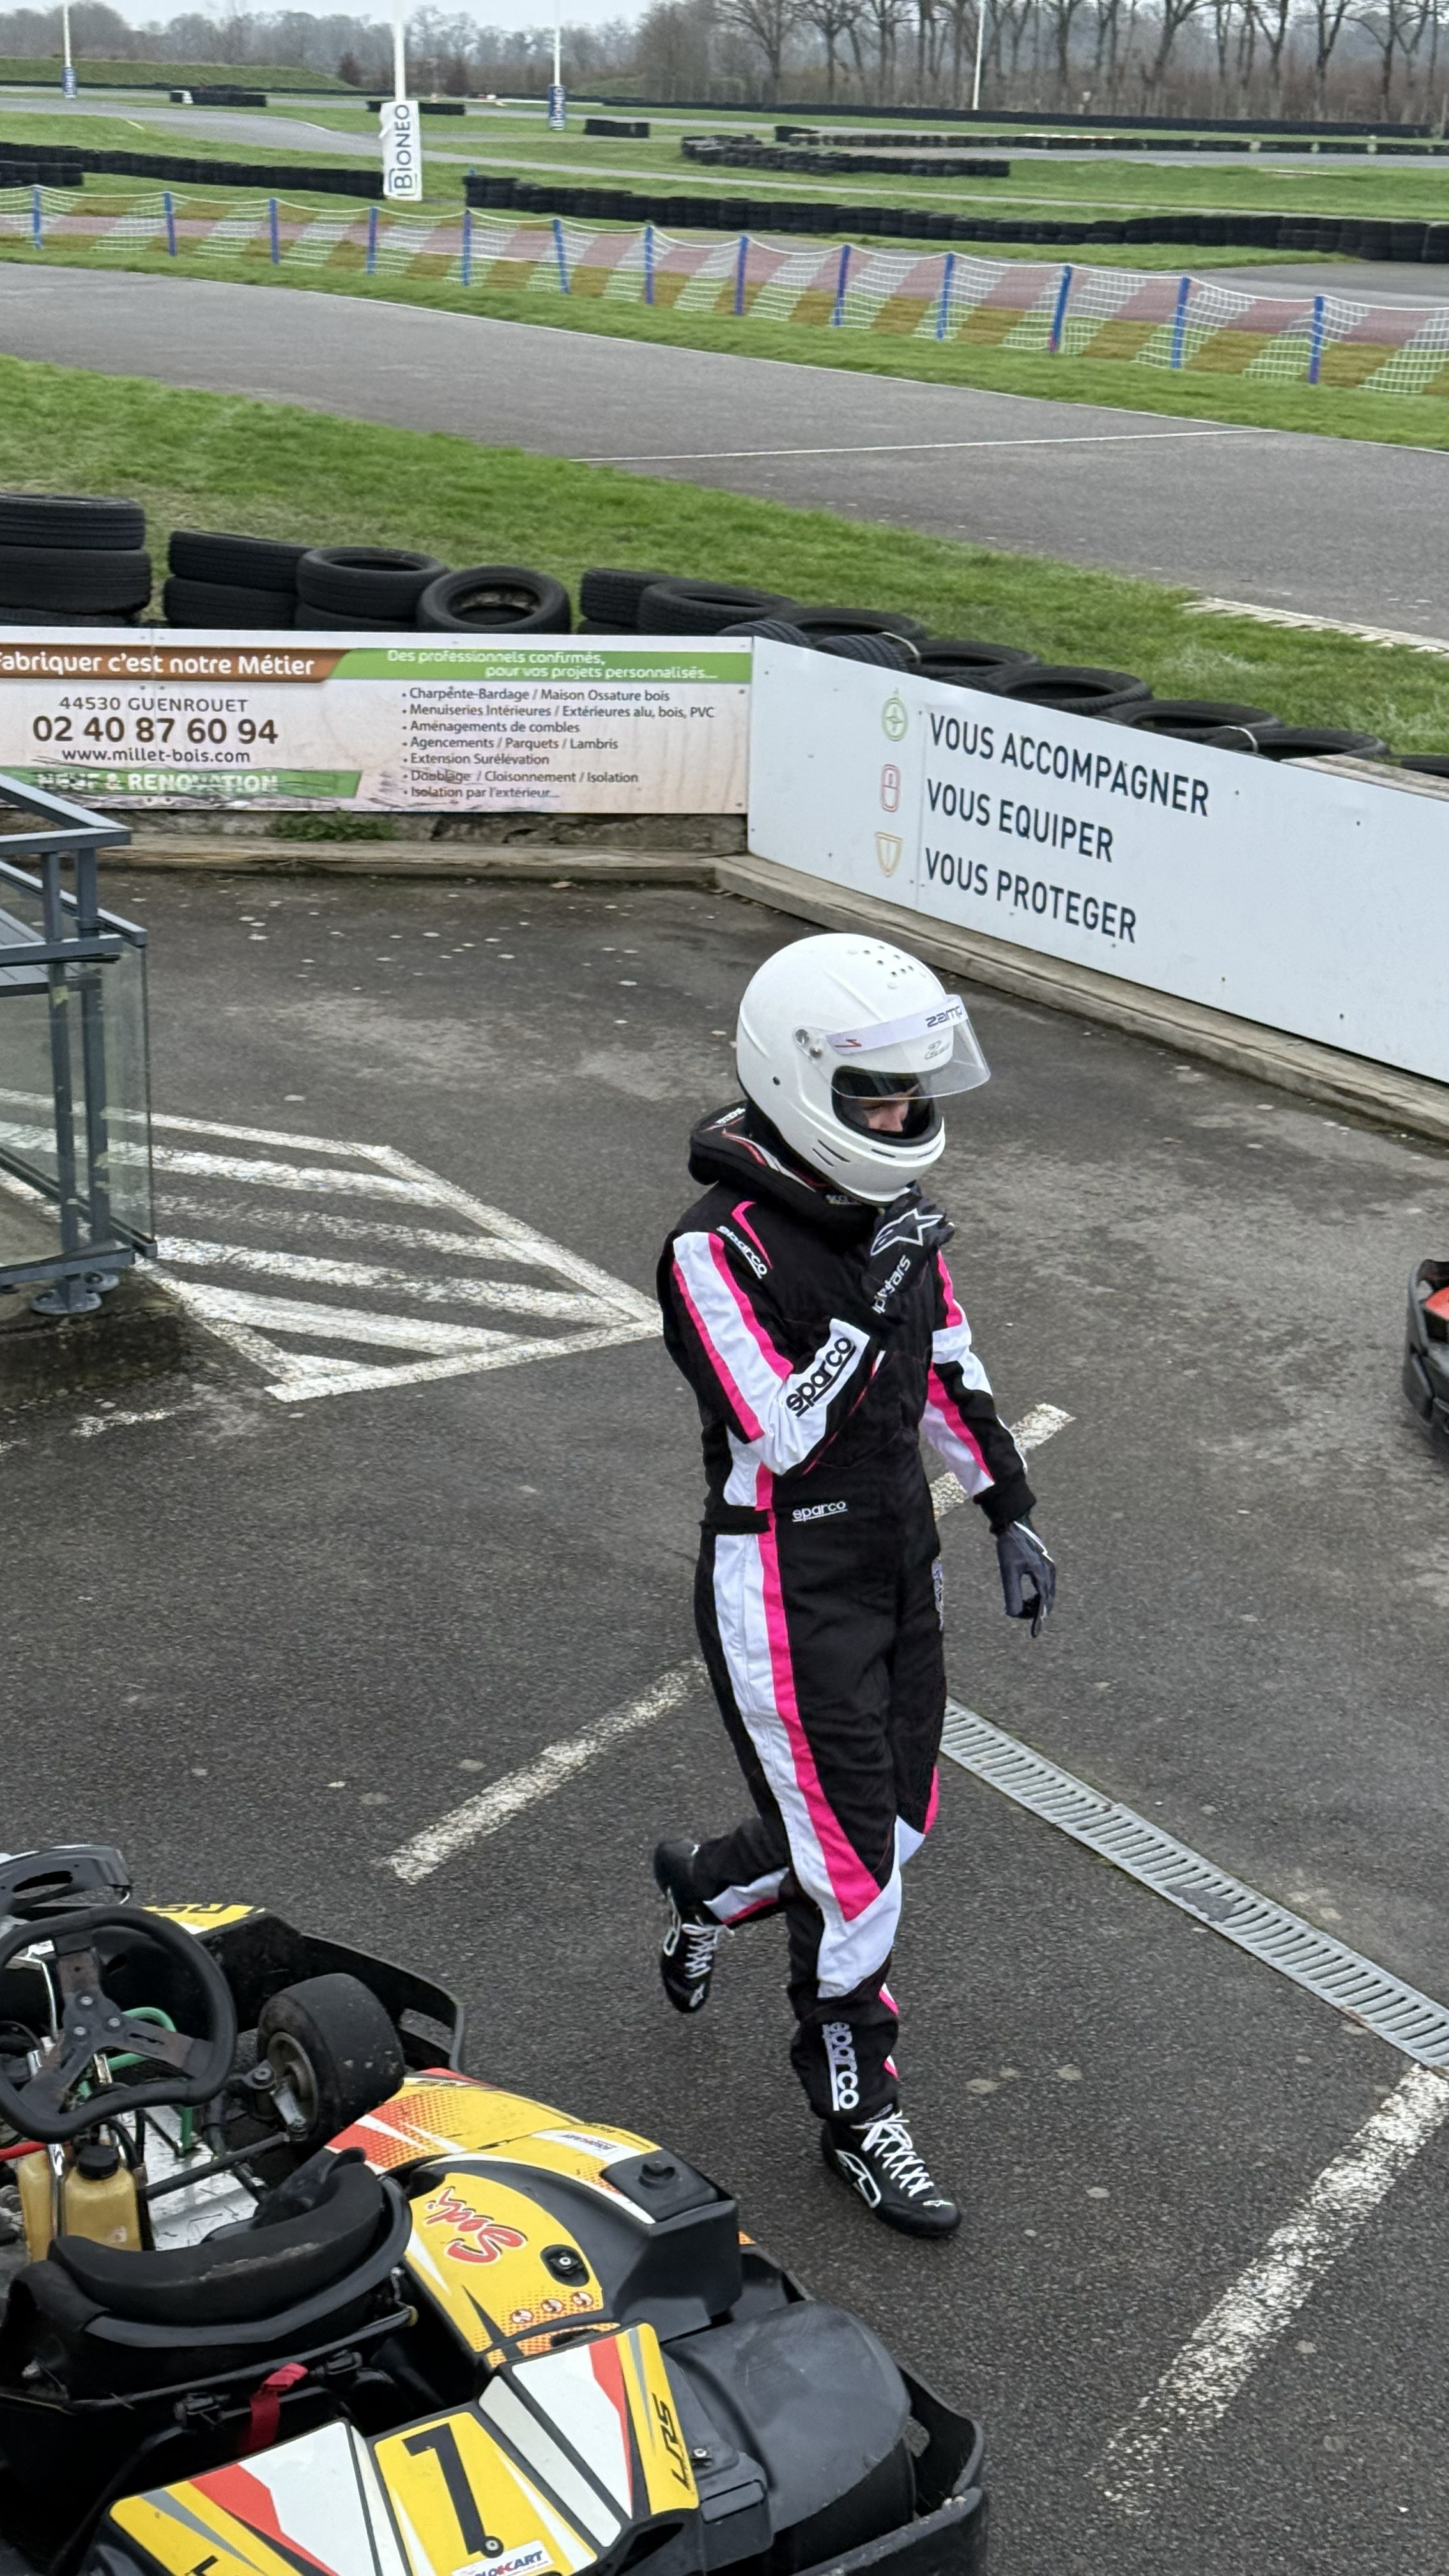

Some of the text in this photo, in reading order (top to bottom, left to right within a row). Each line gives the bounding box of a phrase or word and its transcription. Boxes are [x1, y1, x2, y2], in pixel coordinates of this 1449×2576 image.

[392, 104, 414, 190] BIONEO
[107, 653, 164, 673] c'est
[169, 656, 232, 674] notre
[238, 654, 315, 675] Métier
[387, 650, 606, 665] Des professionnels confirmés,
[485, 667, 519, 678] pour
[522, 668, 548, 677] vos
[551, 666, 602, 680] projets
[410, 687, 530, 702] Charpente-Bardage
[541, 689, 584, 700] Maison
[588, 689, 641, 701] Ossature
[645, 689, 670, 701] bois
[58, 697, 249, 712] 44530 GUENROUET
[410, 704, 483, 716] Menuiseries
[487, 704, 551, 716] Intérieures
[563, 705, 631, 717] Extérieures
[634, 706, 656, 719] alu,
[659, 705, 686, 719] bois,
[690, 707, 715, 718] PVC
[33, 716, 279, 744] 02 40 87 60 94
[410, 720, 580, 734] Aménagements de combles
[410, 737, 494, 750] Agencements
[505, 737, 559, 751] Parquets
[570, 738, 618, 749] Lambris
[61, 747, 250, 763] www.millet-bois.com
[411, 753, 549, 765] Extension Surélévation
[930, 712, 1209, 818] VOUS ACCOMPAGNER
[411, 770, 471, 784] Doublage
[485, 770, 576, 782] Cloisonnement
[587, 772, 638, 783] Isolation
[411, 786, 463, 797] Isolation
[466, 788, 486, 799] par
[927, 778, 1114, 863] VOUS EQUIPER
[924, 847, 1137, 944] VOUS PROTEGER
[786, 1337, 854, 1414] sparco
[792, 1501, 847, 1522] sparco
[822, 2021, 859, 2110] sparco
